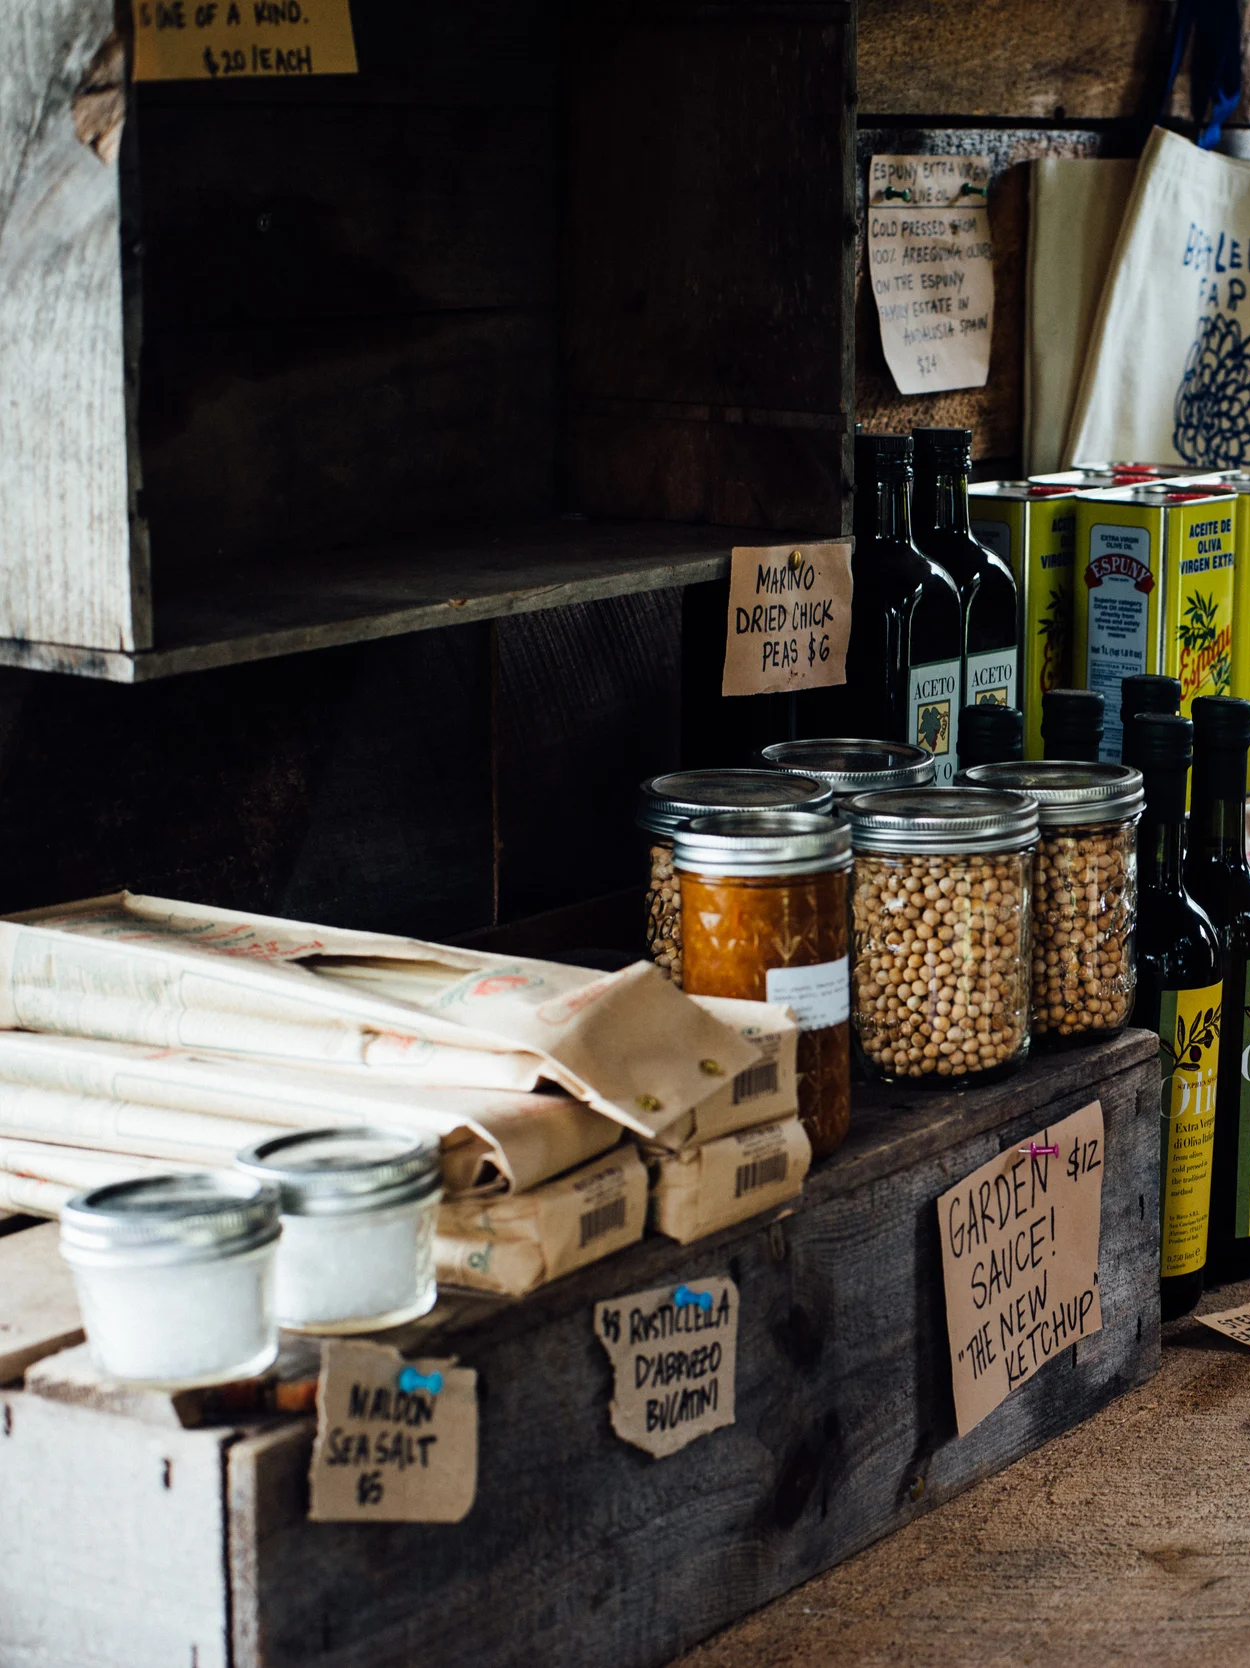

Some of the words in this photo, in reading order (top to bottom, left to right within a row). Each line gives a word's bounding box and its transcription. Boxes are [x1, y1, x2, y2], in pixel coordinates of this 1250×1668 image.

[195, 2, 218, 28] OF
[226, 3, 241, 26] A
[901, 220, 946, 238] PRESSED
[872, 248, 896, 264] 100%
[875, 280, 890, 295] ON
[895, 273, 913, 291] THE
[921, 270, 964, 295] ESPUNY
[913, 297, 952, 318] ESTATE
[958, 296, 970, 310] IN
[960, 313, 988, 337] SPAIN
[1100, 534, 1119, 542] EXTRA
[1120, 536, 1139, 544] VIRGIN
[1189, 520, 1218, 538] ACEITE
[1220, 519, 1231, 533] DE
[1106, 541, 1122, 549] OLIVE
[1197, 538, 1222, 554] OLIVA
[1090, 556, 1151, 582] ESPUNY
[1179, 556, 1210, 576] VIRGEN
[756, 561, 815, 594] MARINO
[736, 604, 786, 634] DRIED
[792, 599, 834, 630] CHICK
[762, 639, 798, 672] PEAS
[808, 631, 830, 667] $6
[972, 664, 1012, 687] ACETO
[913, 676, 955, 700] ACETO
[1175, 1122, 1198, 1134] Extra
[1173, 1137, 1183, 1150] di
[1184, 1135, 1201, 1148] Oliva
[1172, 1164, 1186, 1173] cold
[1187, 1161, 1204, 1173] pressed
[1173, 1153, 1188, 1162] from
[1171, 1176, 1182, 1185] the
[1183, 1172, 1207, 1184] traditional
[949, 1129, 1048, 1259] GARDEN
[1067, 1137, 1101, 1182] $12
[1170, 1187, 1193, 1197] method
[971, 1206, 1057, 1310] SAUCE!
[1000, 1269, 1047, 1352] NEW
[325, 1427, 370, 1467] SEA
[375, 1431, 437, 1471] SALT
